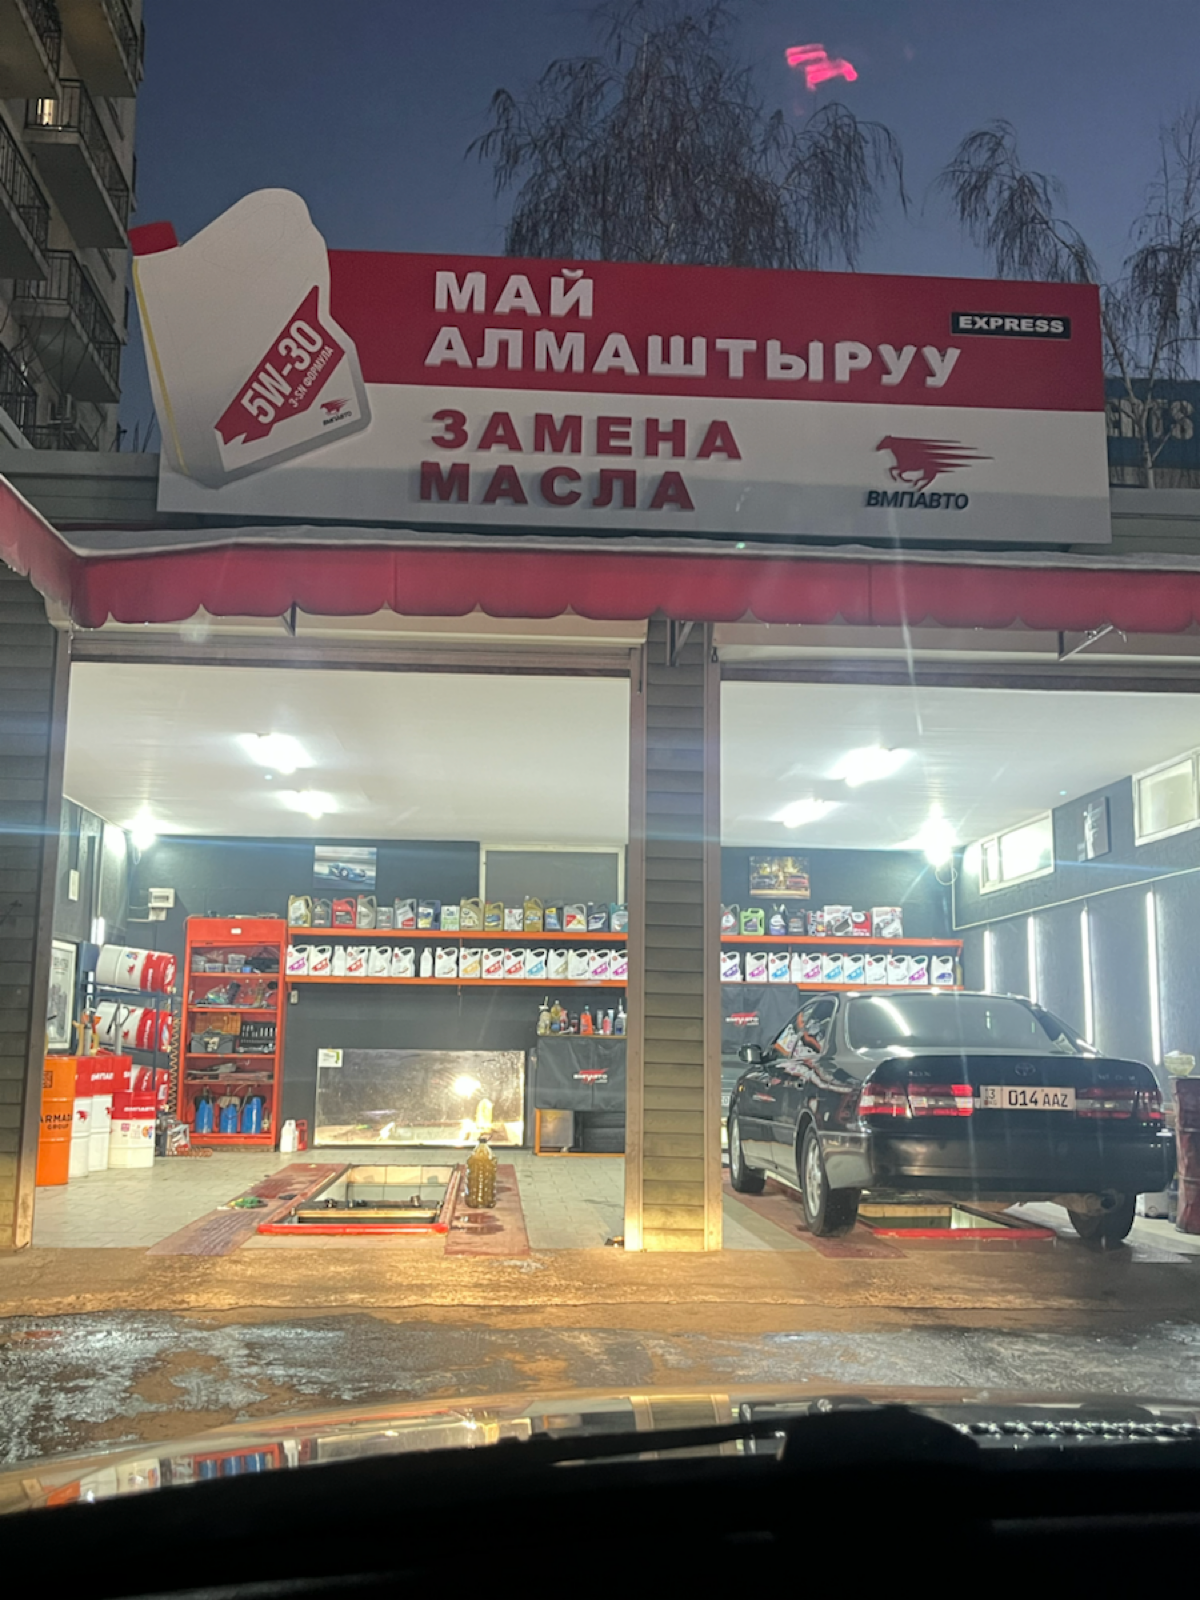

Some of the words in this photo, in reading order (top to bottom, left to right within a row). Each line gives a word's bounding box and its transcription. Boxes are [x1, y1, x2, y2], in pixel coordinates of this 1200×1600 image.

[434, 268, 594, 320] МАЙ
[958, 315, 1065, 334] EXPRESS
[240, 319, 324, 424] 5W-30
[302, 345, 334, 387] ФОРМУЛА
[424, 326, 962, 388] АЛМАШТЫРУУ
[431, 409, 742, 461] ЗАМЕНА
[419, 460, 696, 511] МАСЛА
[865, 490, 970, 510] ВМПАВТО
[1008, 1090, 1038, 1106] 014
[1043, 1093, 1069, 1108] AAZ
